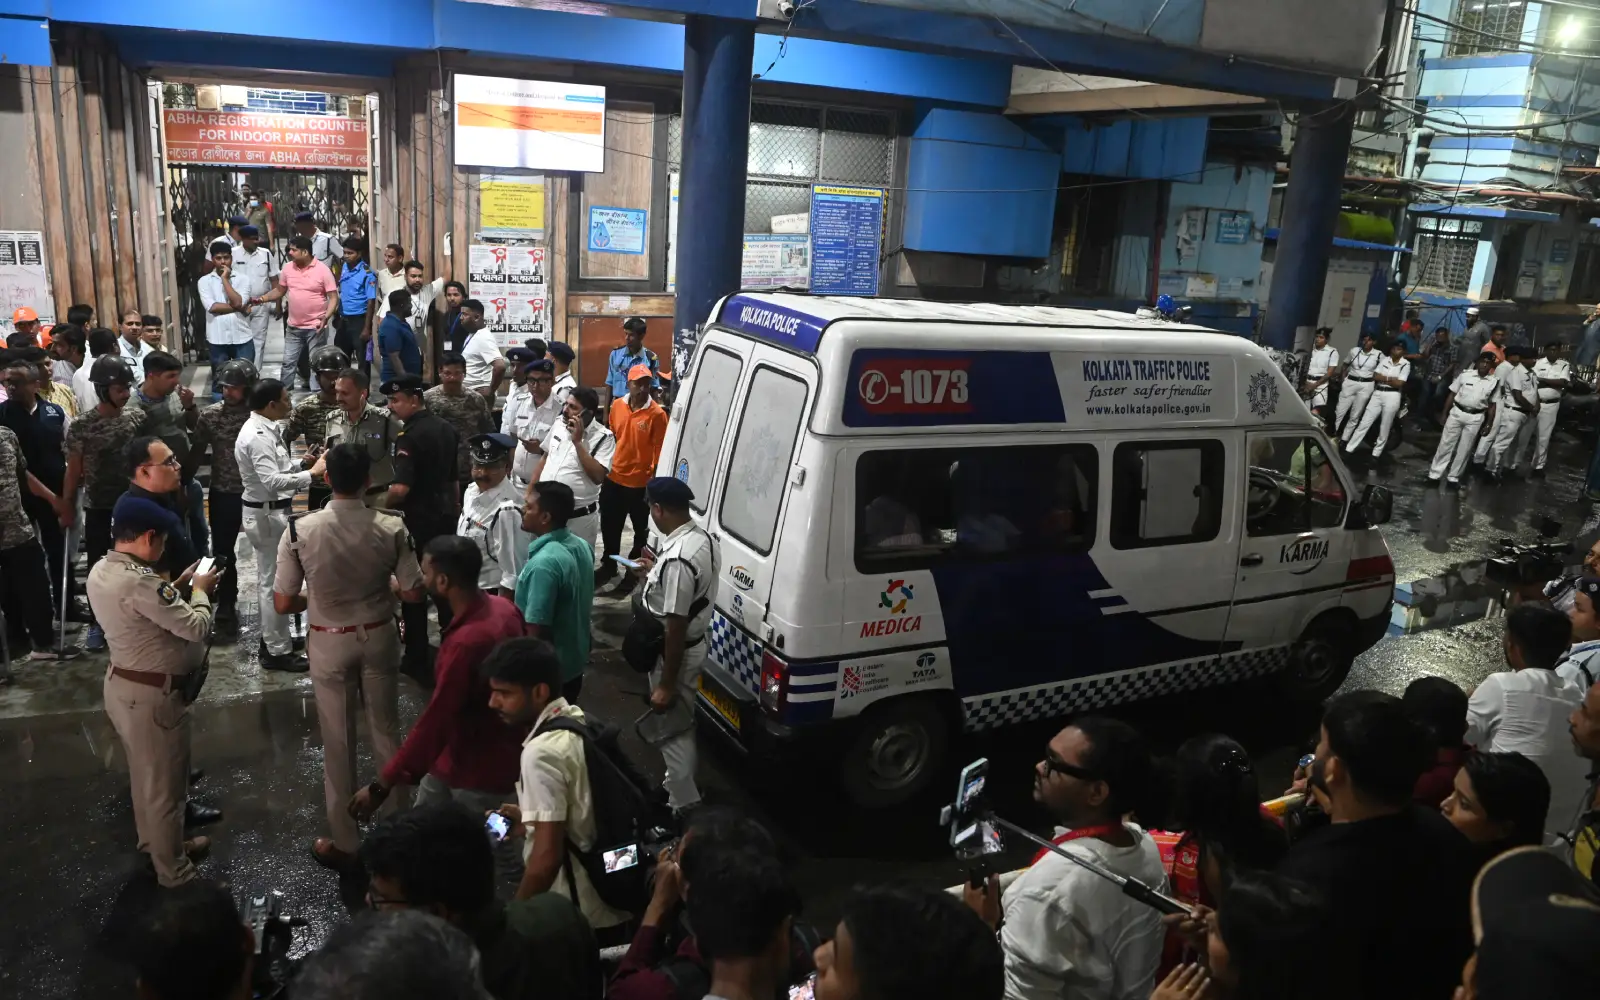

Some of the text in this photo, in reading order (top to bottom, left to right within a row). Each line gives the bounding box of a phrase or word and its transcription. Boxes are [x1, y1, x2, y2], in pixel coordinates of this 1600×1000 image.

[167, 112, 206, 125] ABHA
[208, 114, 305, 130] REGISTRATION
[199, 129, 345, 145] FOR INDOOR PATIENTS
[269, 151, 300, 163] ABHA
[739, 305, 801, 336] KOLKATA POLICE
[1083, 360, 1211, 382] KOLKATA TRAFFIC POLICE
[1085, 383, 1213, 402] faster safer friendlier
[1086, 403, 1211, 416] www.kolkatapolice.gov.in
[1280, 539, 1330, 563] KARMA
[729, 565, 755, 590] KARMA
[860, 615, 922, 638] MEDICA
[912, 668, 936, 678] TATA
